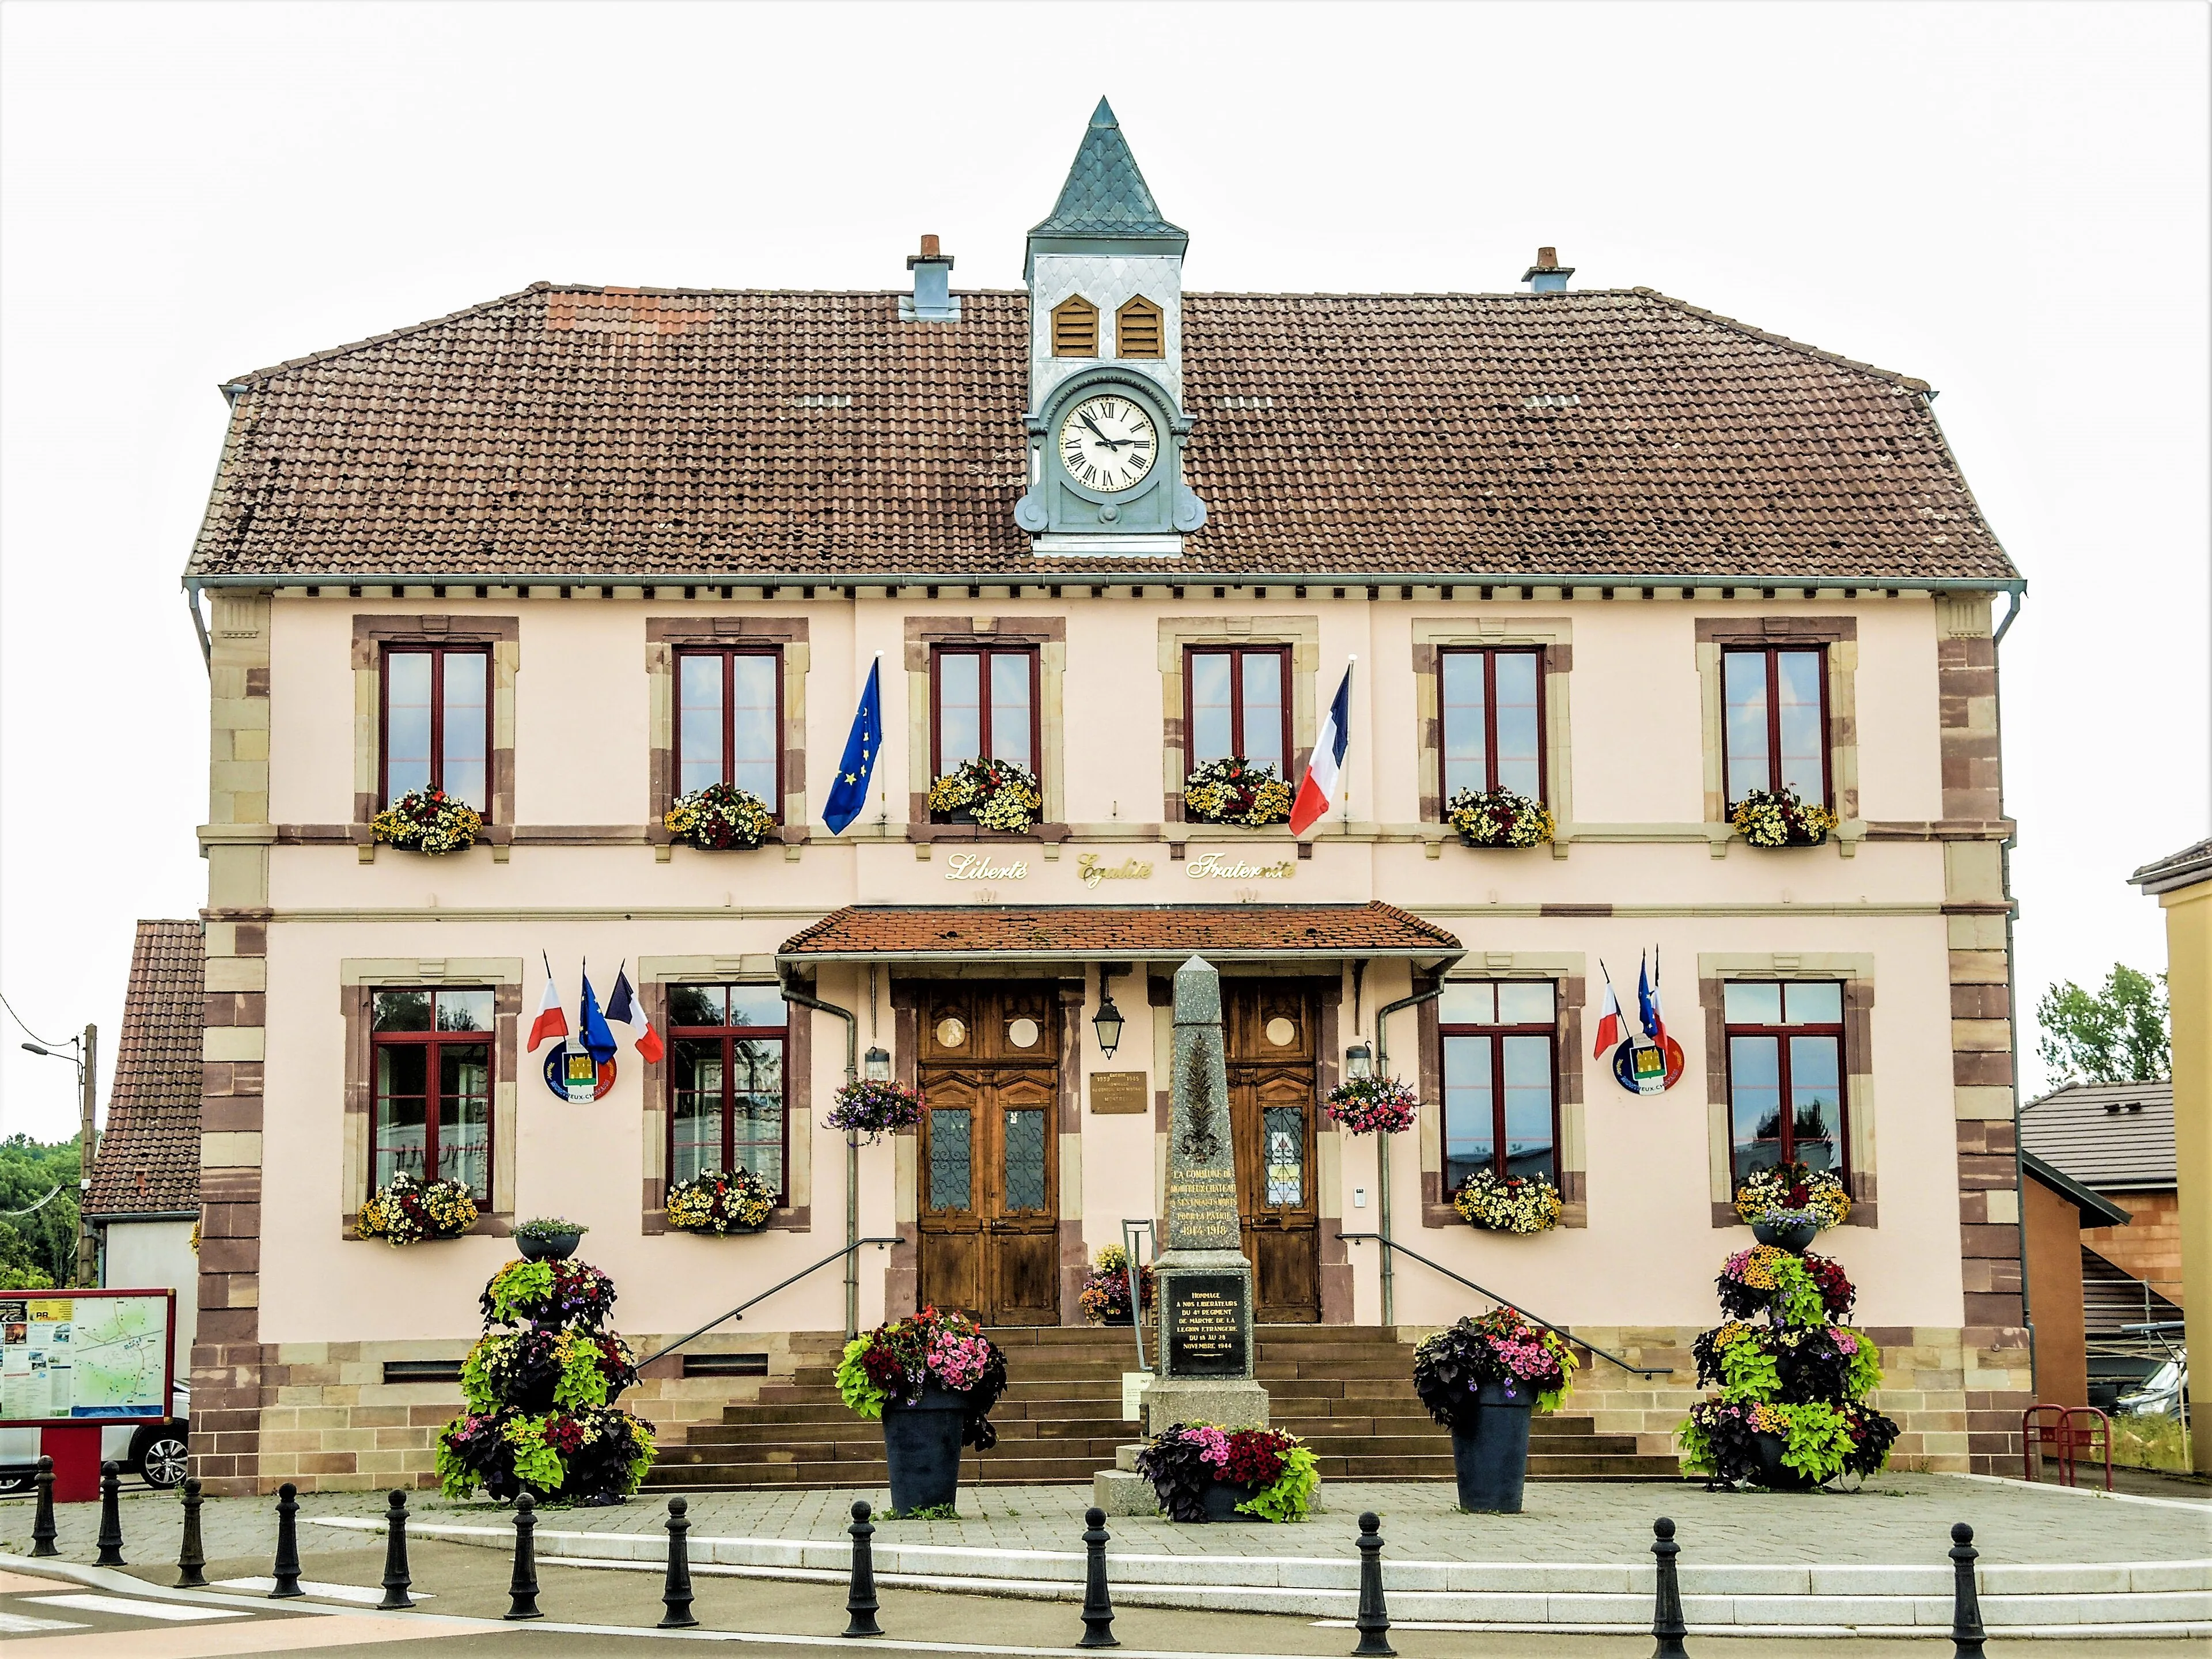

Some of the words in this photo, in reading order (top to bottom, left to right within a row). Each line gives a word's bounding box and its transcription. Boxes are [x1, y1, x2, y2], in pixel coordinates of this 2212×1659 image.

[1100, 403, 1115, 418] XII
[945, 853, 1028, 880] Liberté
[1185, 852, 1297, 879] Fraternité
[1173, 1171, 1184, 1179] LA
[1187, 1170, 1221, 1178] COMMUNE
